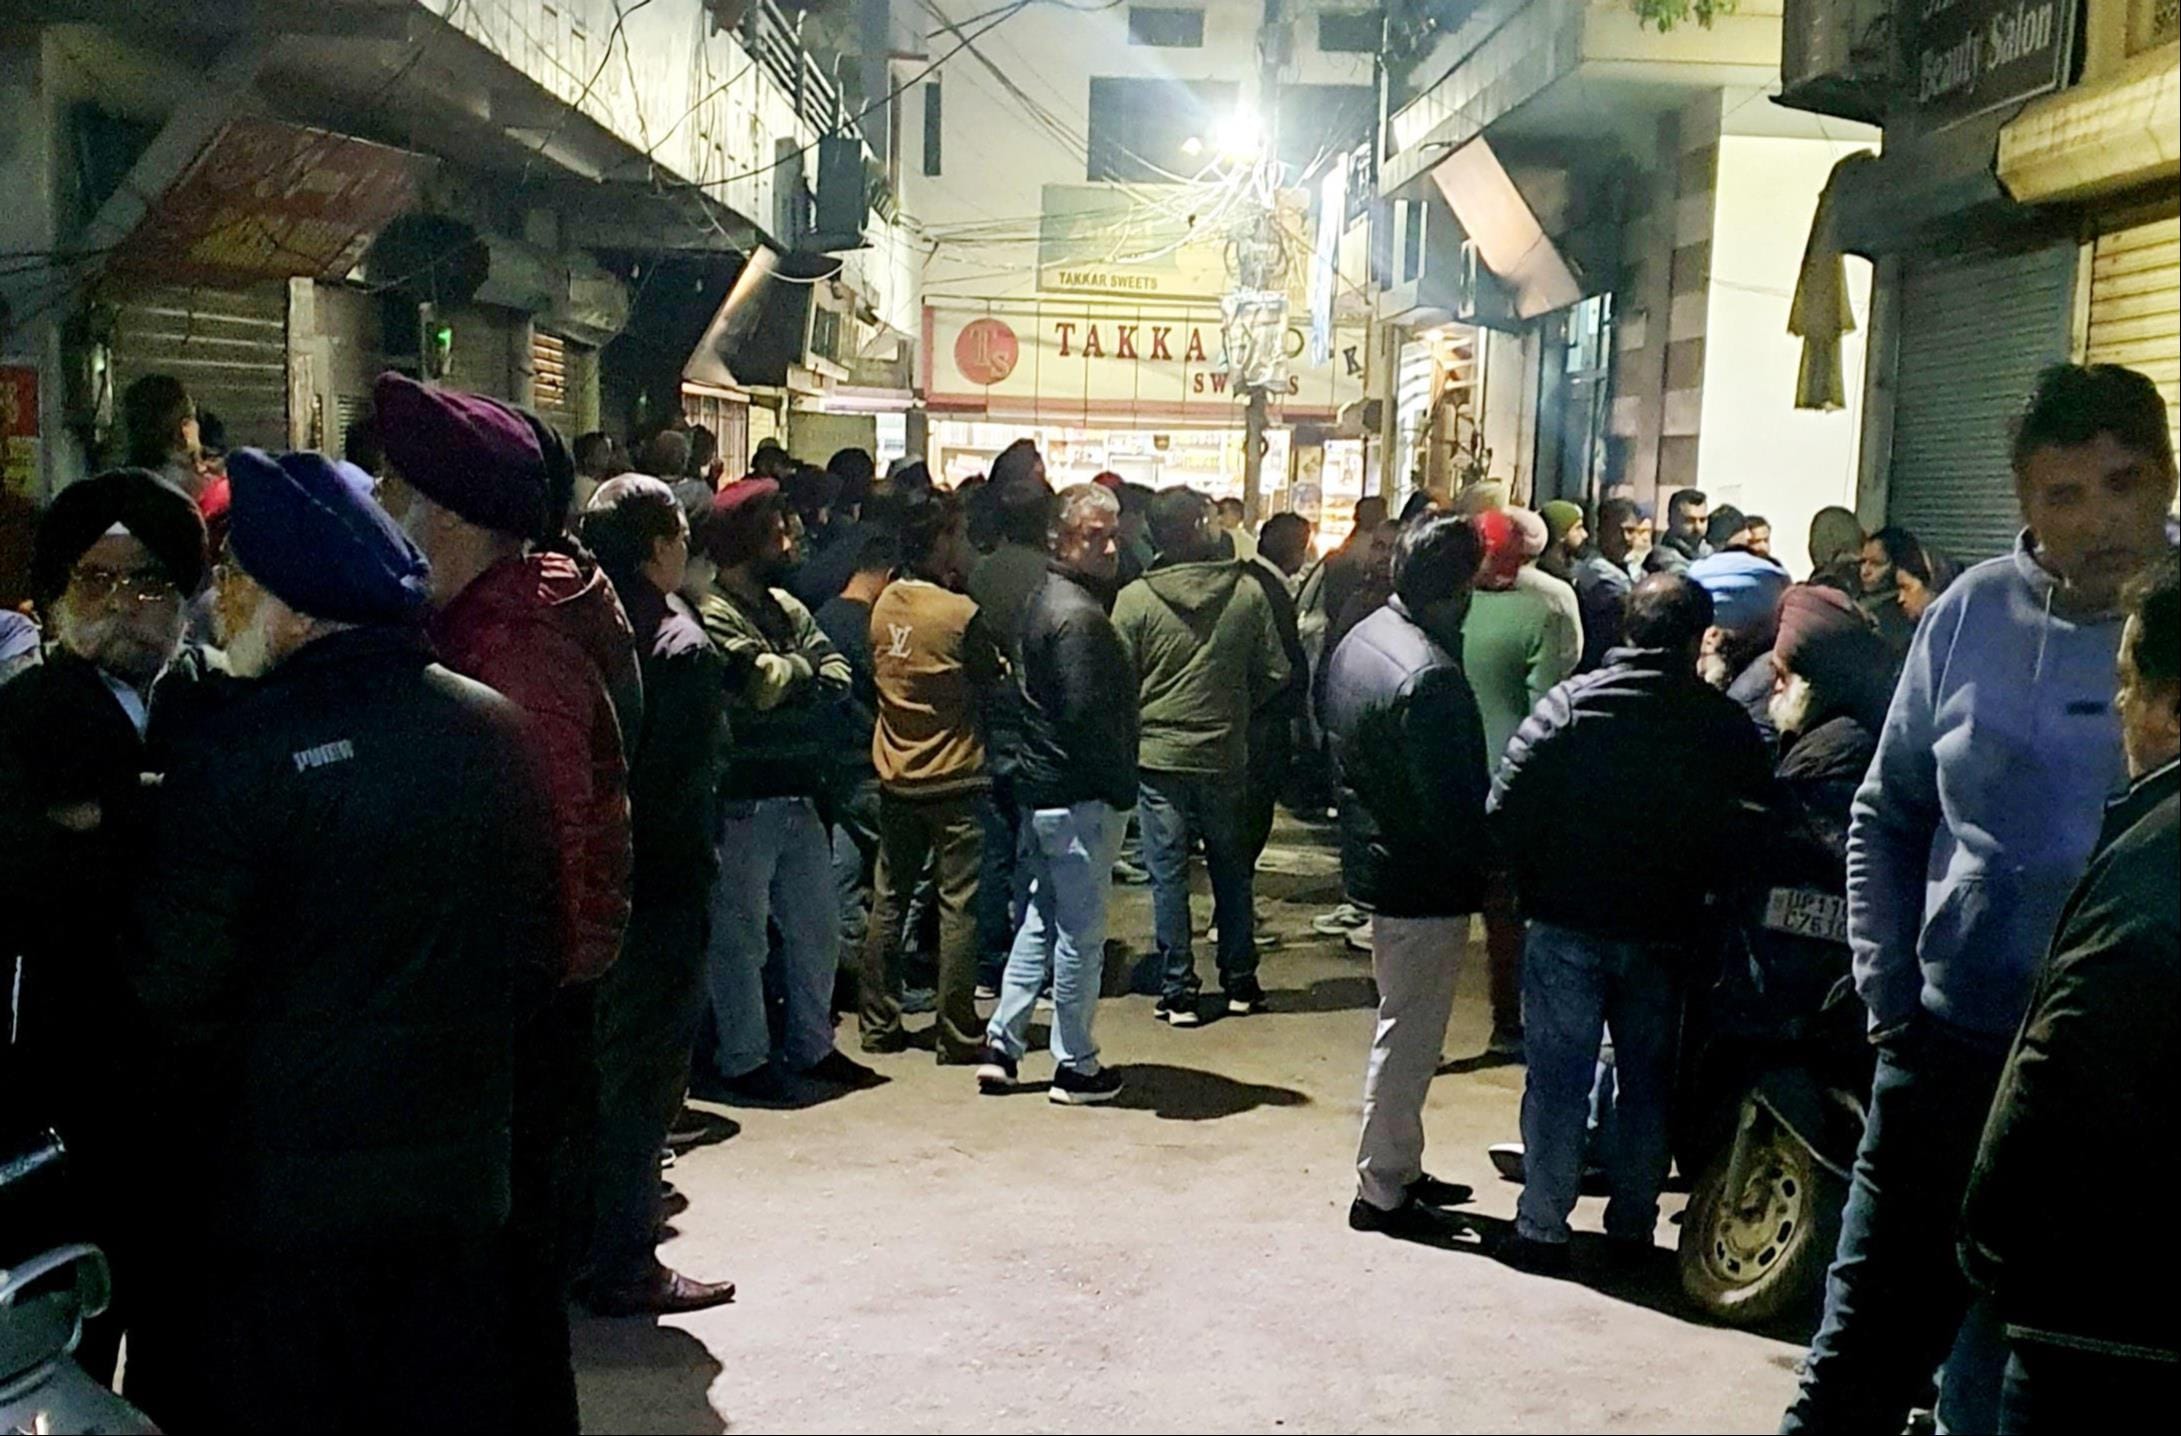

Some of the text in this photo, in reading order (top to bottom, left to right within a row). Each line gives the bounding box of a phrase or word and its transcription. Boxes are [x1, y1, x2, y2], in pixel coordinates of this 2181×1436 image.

[1987, 0, 2053, 71] Salon
[1058, 271, 1157, 290] TAKKAR SWEETS
[1055, 322, 1207, 362] TAKKA
